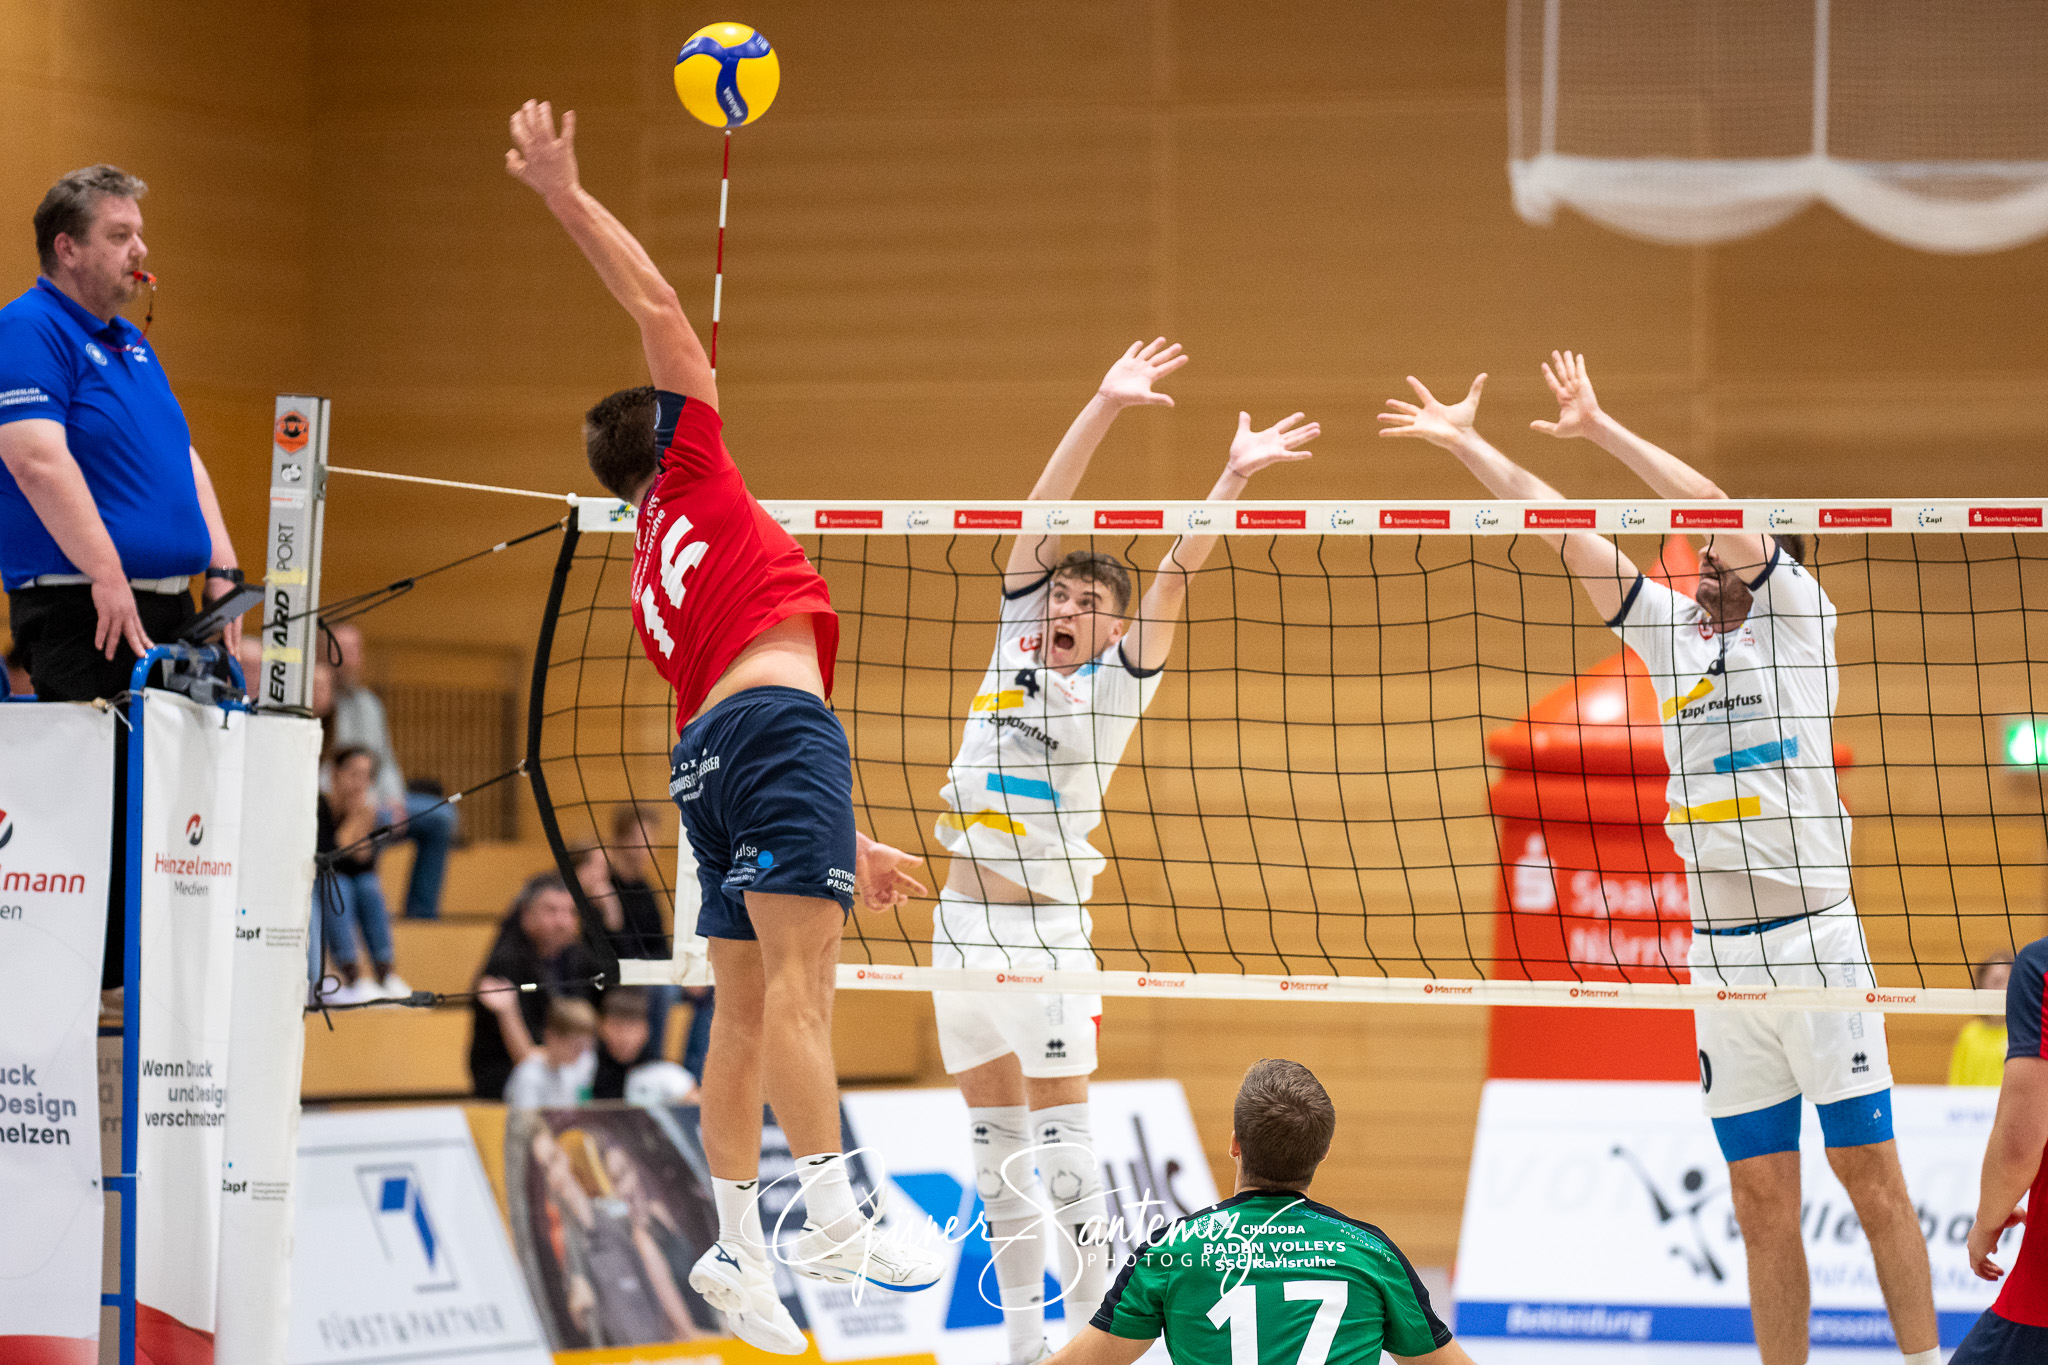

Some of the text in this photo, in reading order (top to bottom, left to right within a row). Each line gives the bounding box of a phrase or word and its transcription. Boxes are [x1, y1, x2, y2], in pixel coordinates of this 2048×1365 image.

[1194, 518, 1211, 526] Zapf
[1338, 518, 1354, 526] Zapf
[1482, 518, 1499, 526] Zapf
[1628, 517, 1645, 525] Zapf
[1776, 517, 1793, 525] Zapf
[1925, 516, 1943, 524] Zapf
[276, 522, 294, 571] PORT
[269, 588, 290, 703] ERARD
[1, 870, 86, 894] mann
[174, 880, 209, 896] Medien
[867, 971, 904, 981] Marmot
[1006, 974, 1044, 984] Marmot
[1148, 978, 1185, 988] Marmot
[1290, 981, 1328, 991] Marmot
[1434, 985, 1473, 994] Marmot
[1580, 989, 1619, 998] Marmot
[1728, 992, 1767, 1001] Marmot
[1877, 994, 1916, 1003] Marmot
[142, 1059, 184, 1077] Wenn
[168, 1083, 227, 1108] und Desig
[1241, 1224, 1306, 1235] CHUDOBA
[1203, 1240, 1347, 1254] BADEN VOLLEYS
[1340, 1228, 1391, 1263] engineering
[1214, 1256, 1337, 1272] SSC Karlsruhe
[1206, 1280, 1349, 1365] 17
